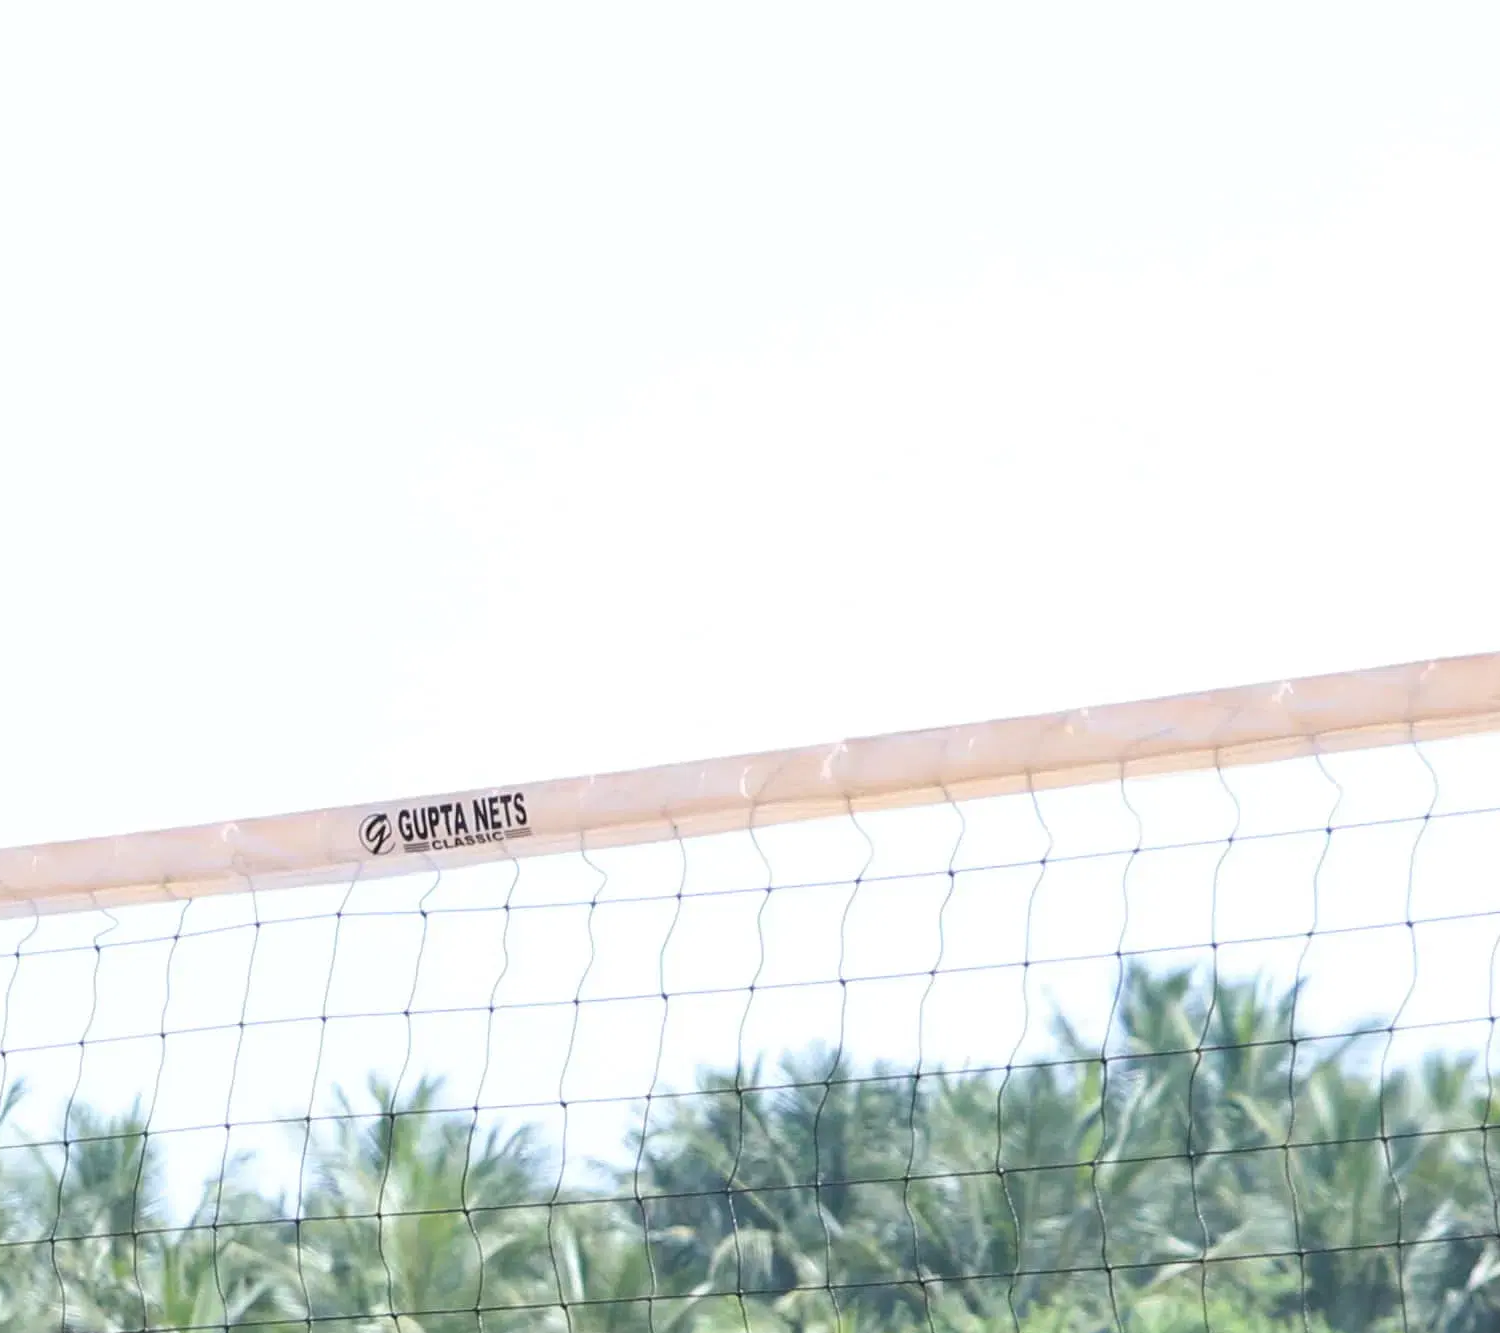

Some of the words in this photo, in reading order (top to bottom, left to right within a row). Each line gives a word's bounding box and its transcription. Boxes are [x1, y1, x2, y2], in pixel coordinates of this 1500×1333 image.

[398, 803, 469, 841] GUPTA
[473, 793, 527, 832] NETS
[431, 831, 505, 851] CLASSIC
